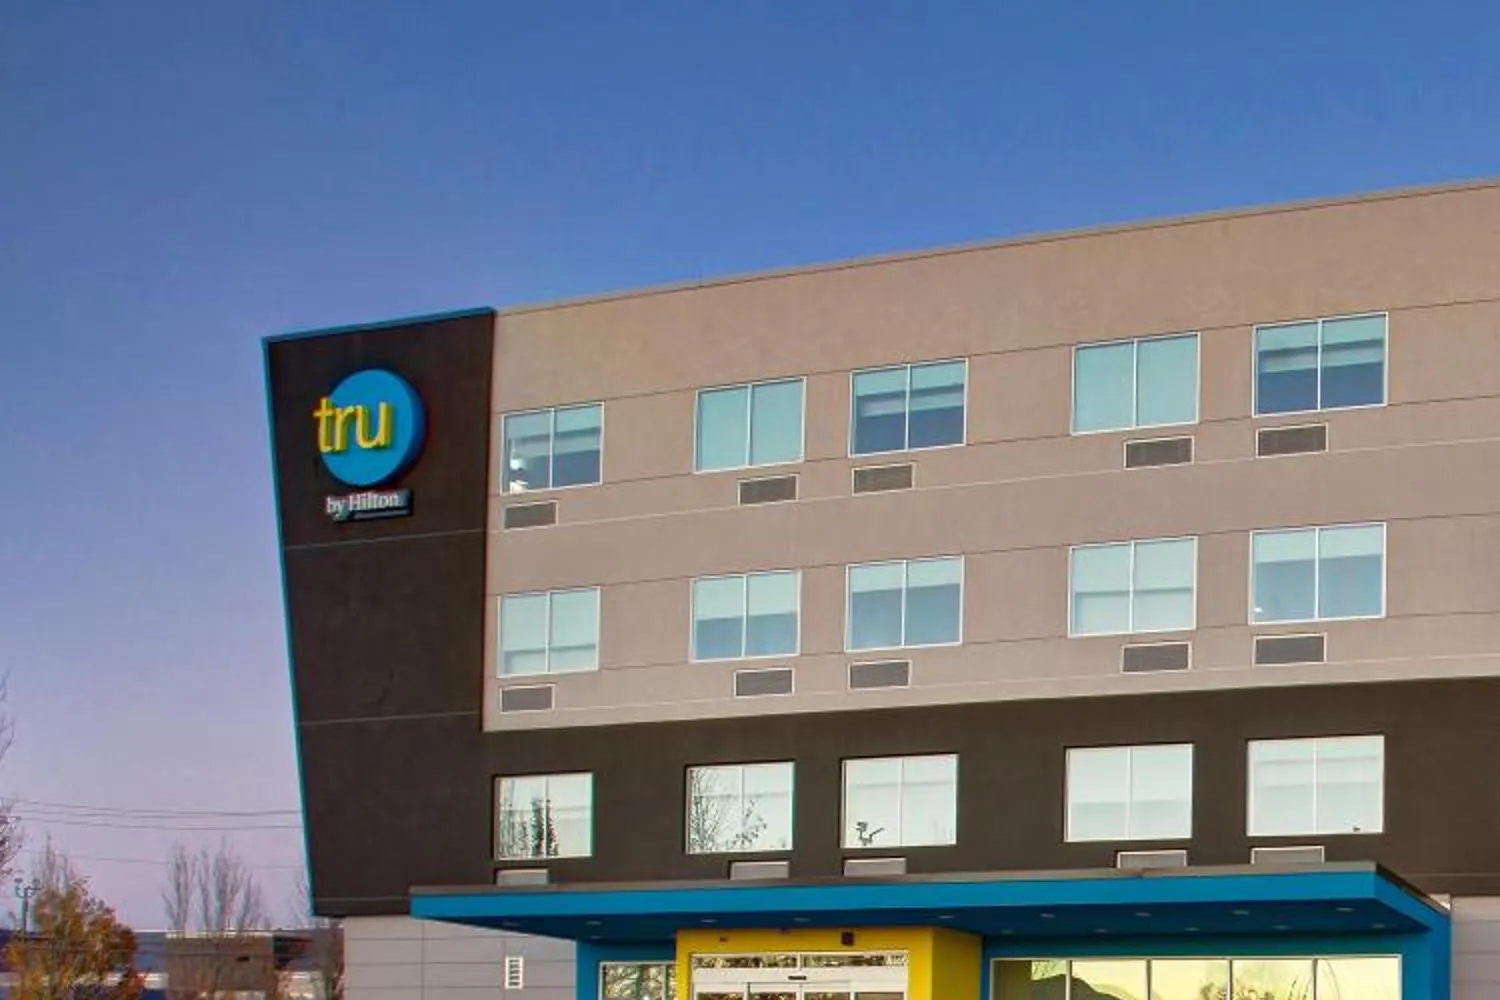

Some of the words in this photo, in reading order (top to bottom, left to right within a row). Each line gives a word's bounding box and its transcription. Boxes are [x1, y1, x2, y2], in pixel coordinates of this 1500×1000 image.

[313, 397, 392, 453] tru
[326, 496, 346, 520] by
[348, 492, 401, 512] Hilton
